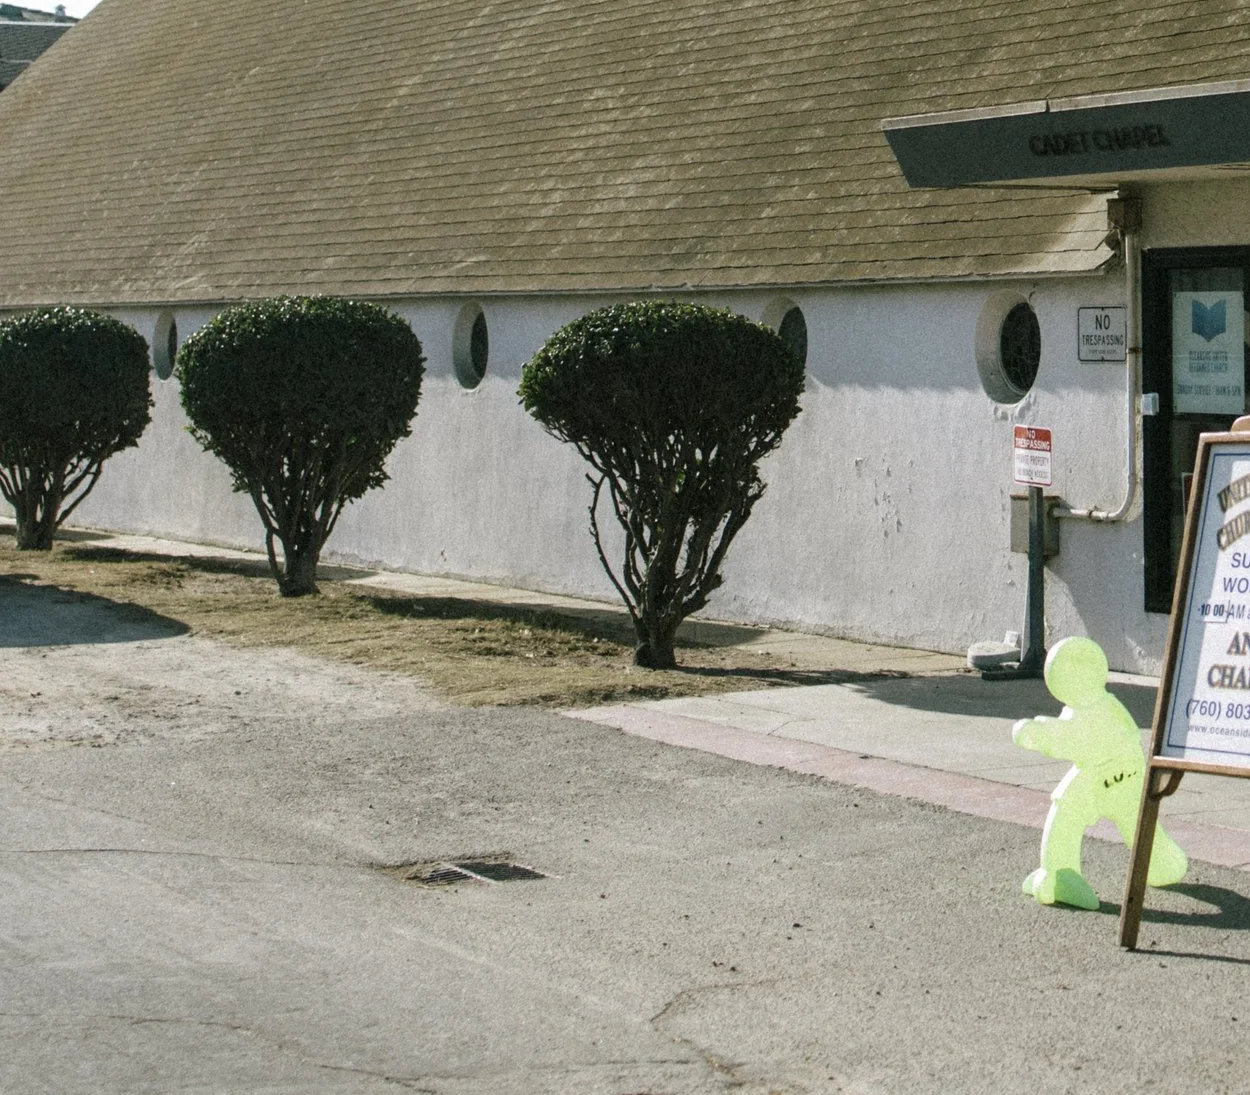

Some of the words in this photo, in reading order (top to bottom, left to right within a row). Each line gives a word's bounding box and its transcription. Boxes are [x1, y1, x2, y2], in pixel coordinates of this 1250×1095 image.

[1029, 132, 1090, 156] CADET
[1092, 123, 1171, 151] CHAPEL
[1095, 314, 1111, 330] NO
[1082, 334, 1124, 346] TRESPASSING
[1015, 438, 1050, 451] TRESPASSING
[1227, 604, 1246, 620] AM
[1186, 698, 1222, 721] (760)
